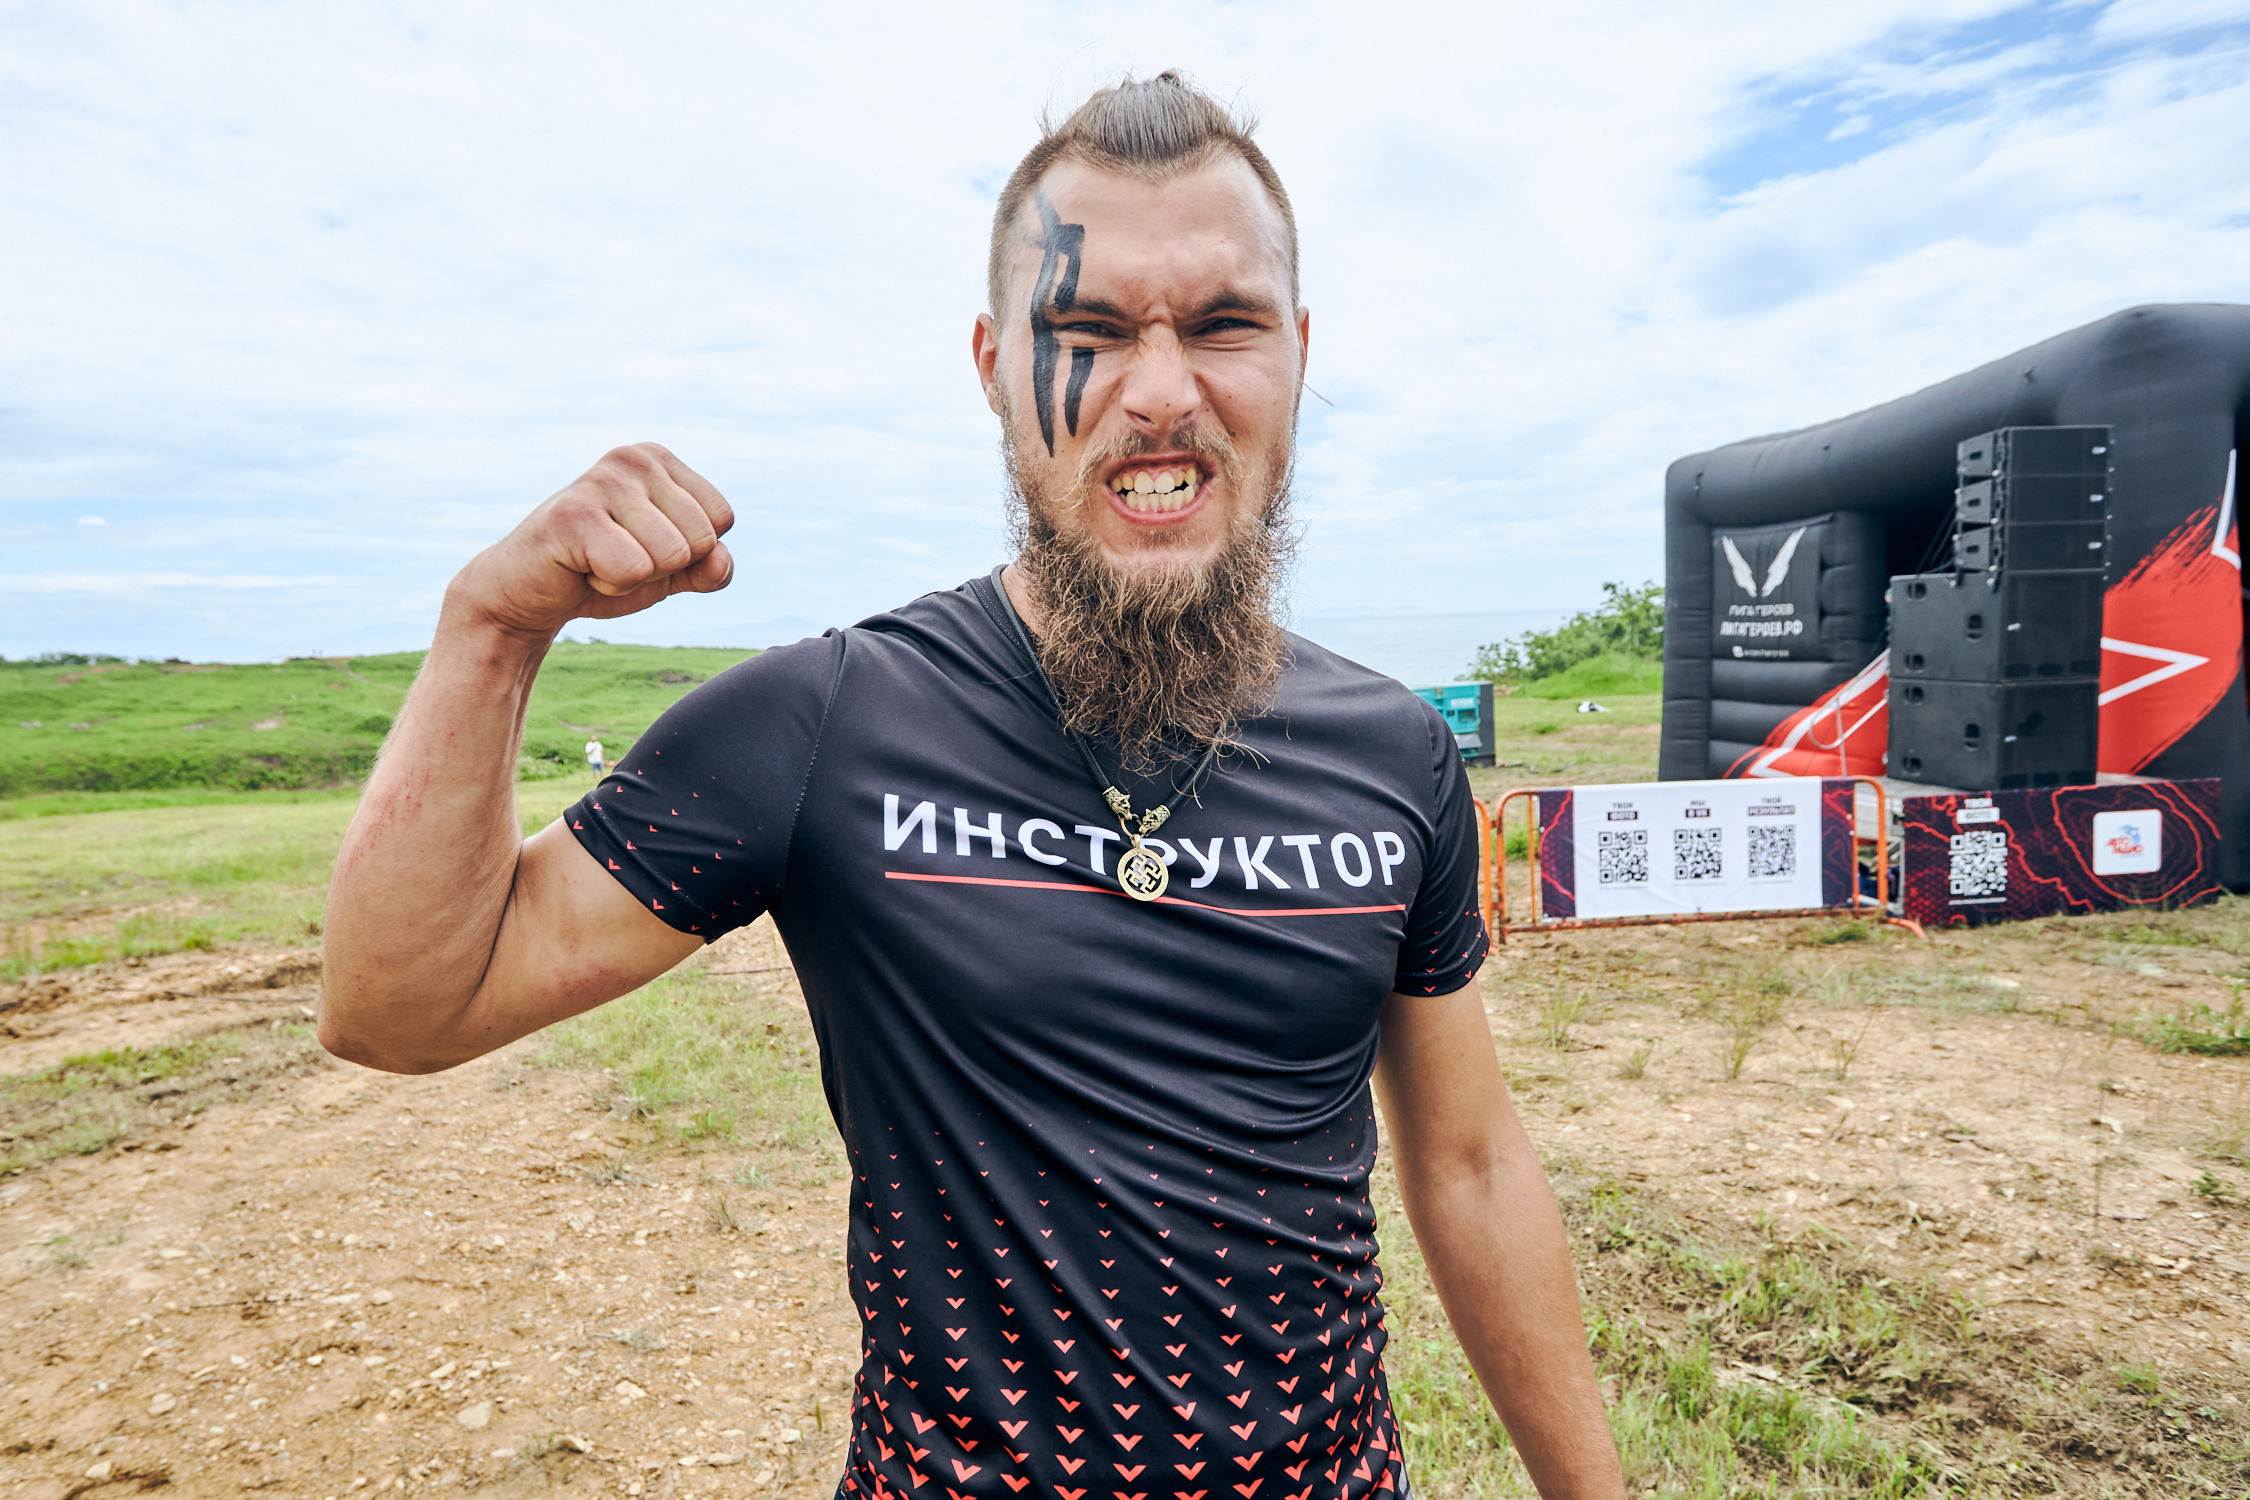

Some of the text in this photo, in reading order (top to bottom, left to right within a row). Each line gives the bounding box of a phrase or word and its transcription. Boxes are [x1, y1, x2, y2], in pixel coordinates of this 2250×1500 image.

[1755, 602, 1794, 617] ГЕРОЕВ
[1720, 619, 1803, 637] ЛИГАГЕРОЕВ.РФ
[884, 793, 1406, 890] ИНСТРУКТОР
